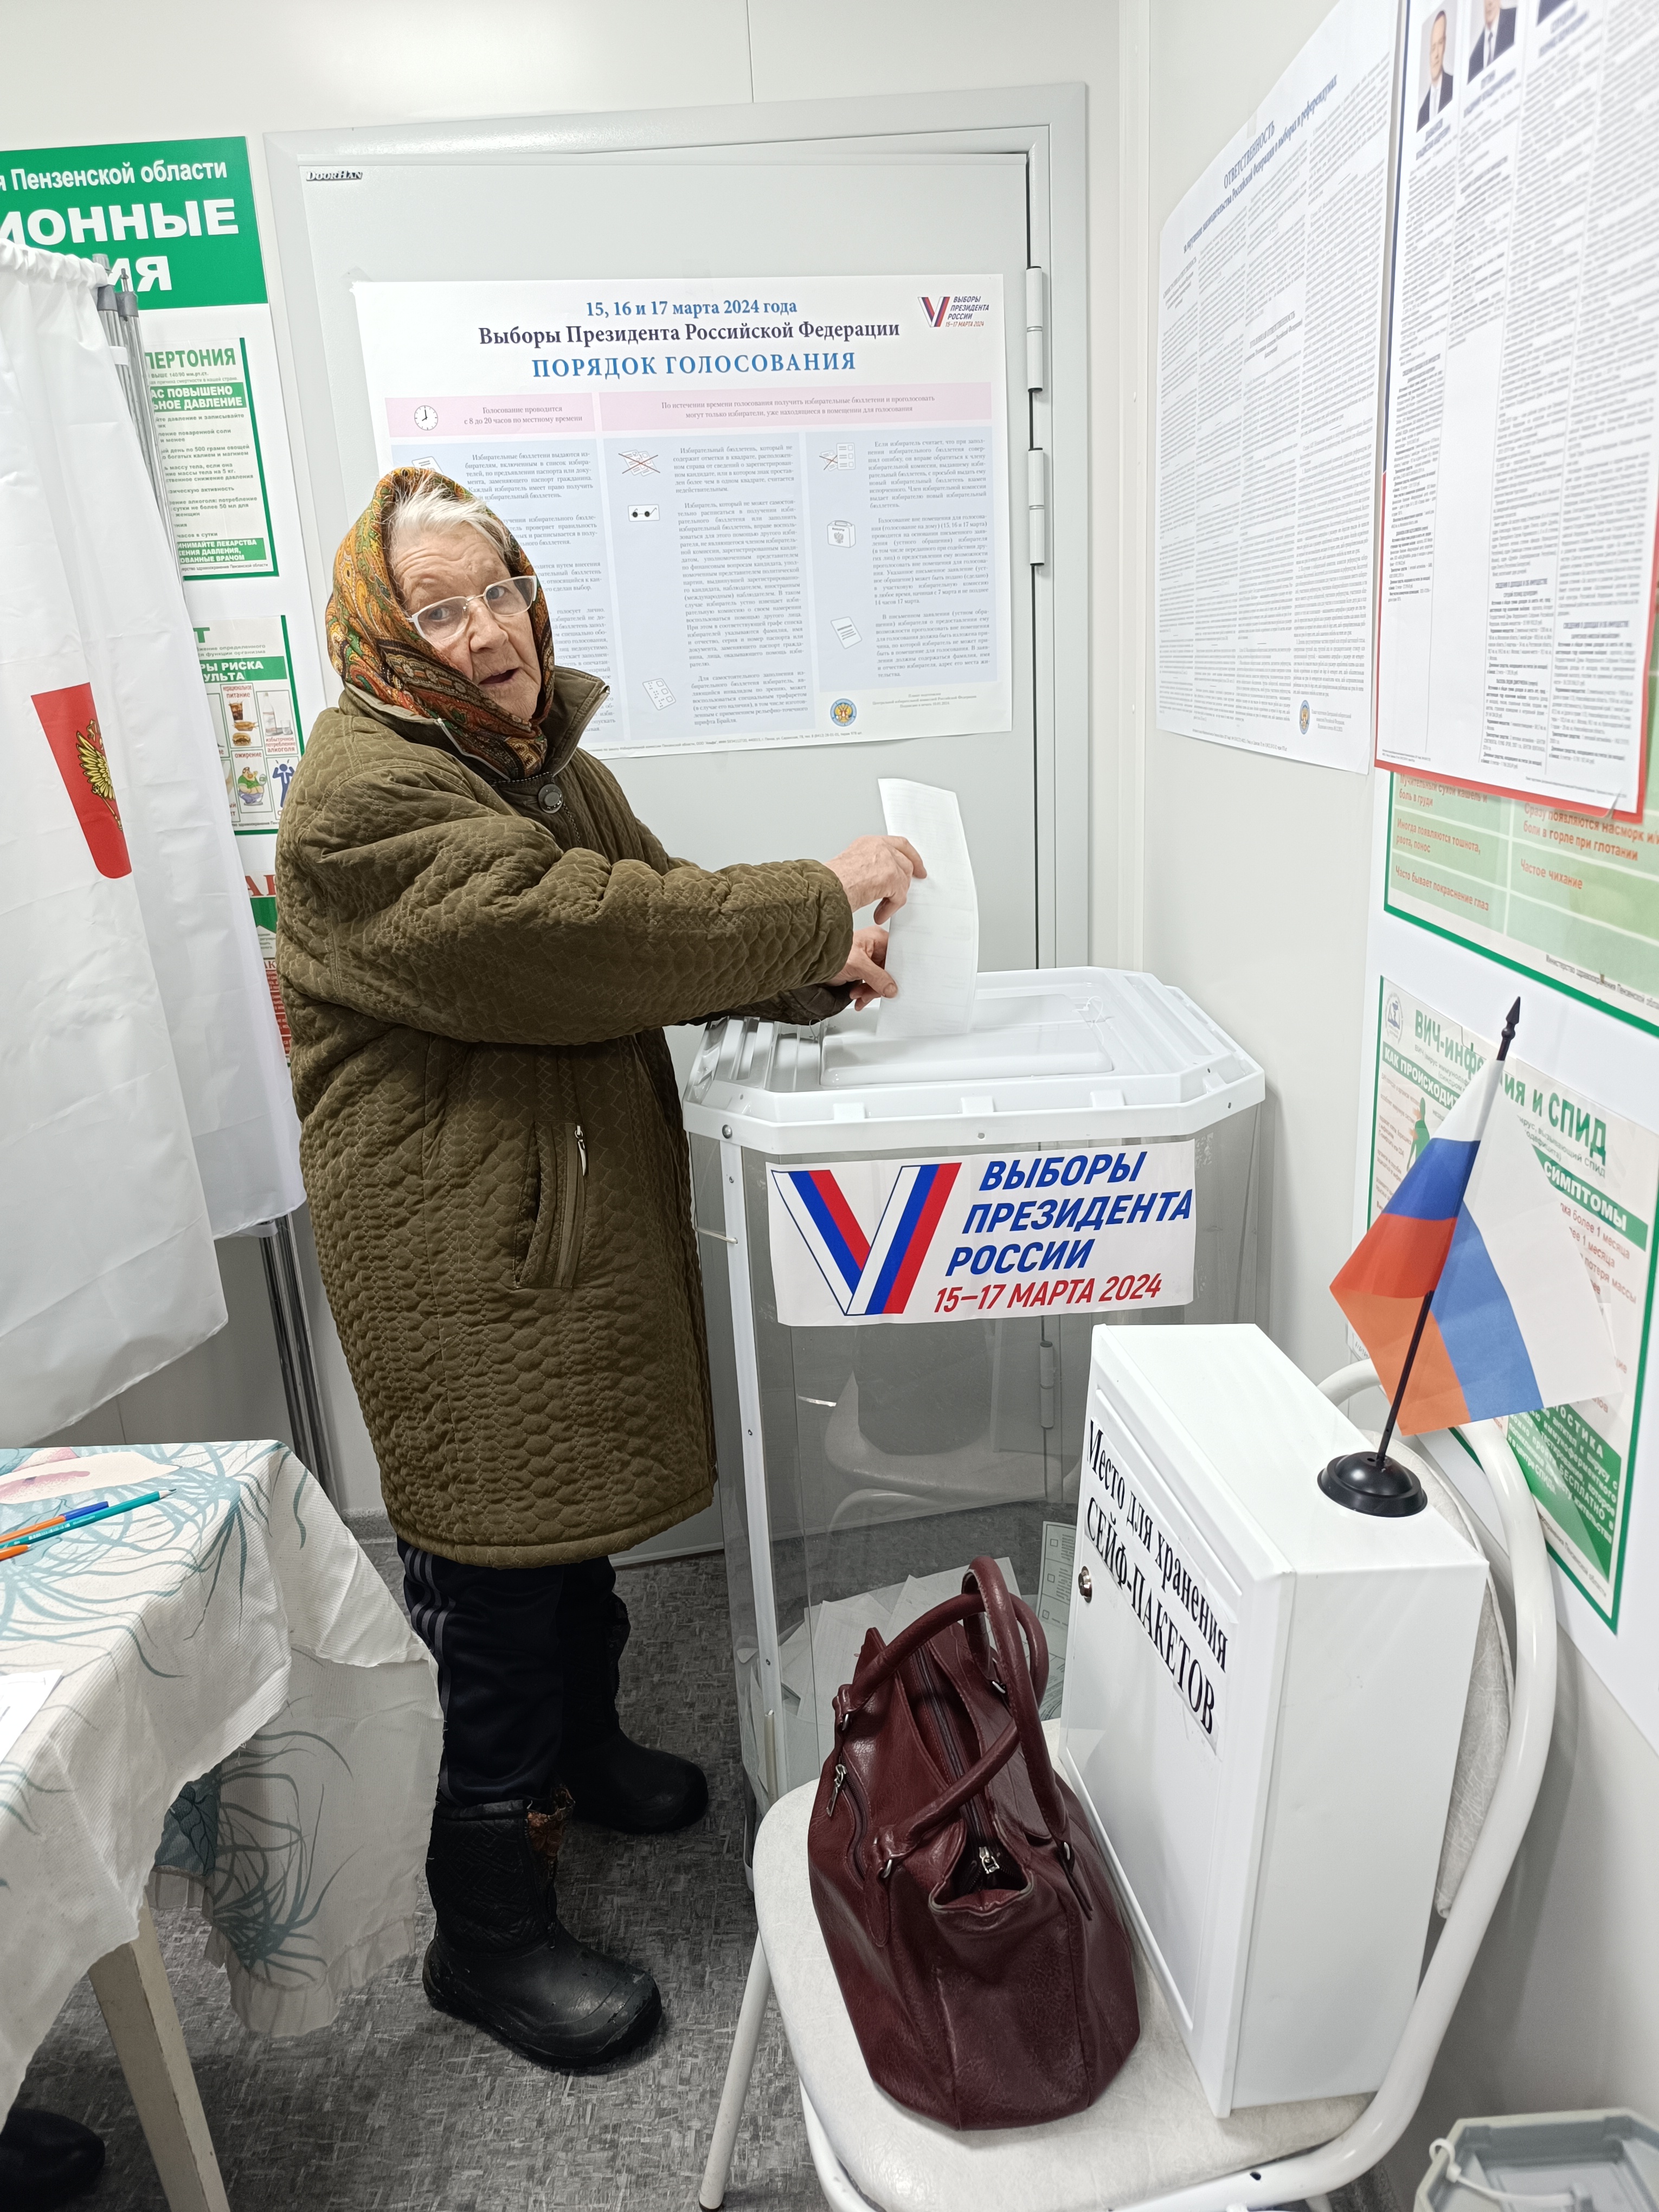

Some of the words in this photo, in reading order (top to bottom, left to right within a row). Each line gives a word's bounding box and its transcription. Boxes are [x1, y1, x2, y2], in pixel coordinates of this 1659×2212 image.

[1224, 120, 1275, 189] ОТВЕТСТВЕННОСТЬ
[11, 162, 135, 191] Пензенской
[140, 159, 227, 183] области
[587, 302, 609, 318] 15,
[614, 301, 632, 316] 16
[636, 304, 646, 316] и
[651, 300, 668, 314] 17
[672, 303, 719, 318] марта
[724, 300, 759, 313] 2024
[763, 301, 797, 316] года
[479, 326, 561, 349] Выборы
[566, 325, 680, 347] Президента
[685, 320, 793, 340] Российской
[799, 320, 899, 342] Федерации
[532, 356, 658, 380] ПОРЯДОК
[666, 352, 856, 375] ГОЛОСОВАНИЯ
[167, 385, 233, 397] ПОВЫШЕНО
[184, 397, 242, 410] ДАВЛЕНИЕ
[805, 397, 850, 406] избирательные
[202, 548, 241, 556] ДАВЛЕНИЯ,
[222, 661, 263, 671] РИСКА
[1399, 788, 1412, 800] боль
[1418, 795, 1433, 806] груди
[1398, 818, 1417, 833] Иногда
[1418, 825, 1451, 843] появляются
[1525, 803, 1546, 821] Сразу
[1548, 811, 1599, 831] появляются
[1602, 822, 1644, 843] насморк
[1414, 840, 1431, 853] понос
[1542, 829, 1547, 838] в
[1549, 830, 1573, 844] горле
[1576, 837, 1591, 851] при
[1593, 841, 1638, 861] глотании
[1396, 865, 1411, 880] Часто
[1412, 872, 1432, 888] бывает
[1433, 882, 1473, 904] покраснение
[1474, 898, 1489, 911] глаз
[1521, 859, 1546, 878] Частое
[1549, 870, 1583, 890] чихание
[1385, 1047, 1399, 1069] КАК
[1549, 1092, 1606, 1166] СПИД
[979, 1152, 1147, 1192] ВЫБОРЫ
[1585, 1157, 1606, 1179] СПИД
[962, 1189, 1193, 1234] ПРЕЗИДЕНТА
[1544, 1161, 1627, 1232] СИМПТОМЫ
[946, 1239, 1095, 1276] РОССИИ
[1589, 1242, 1615, 1268] месяца
[1603, 1233, 1630, 1259] месяца
[1008, 1278, 1095, 1308] МАРТА
[1098, 1273, 1163, 1302] 2024
[1585, 1257, 1610, 1283] потеря
[1612, 1278, 1636, 1304] массы
[1559, 1464, 1605, 1521] БЕСПЛАТНО
[1086, 1419, 1125, 1510] Место
[1127, 1491, 1153, 1554] для
[1155, 1530, 1228, 1673] хранения
[1087, 1497, 1215, 1734] СЕЙФ-ПАКЕТОВ
